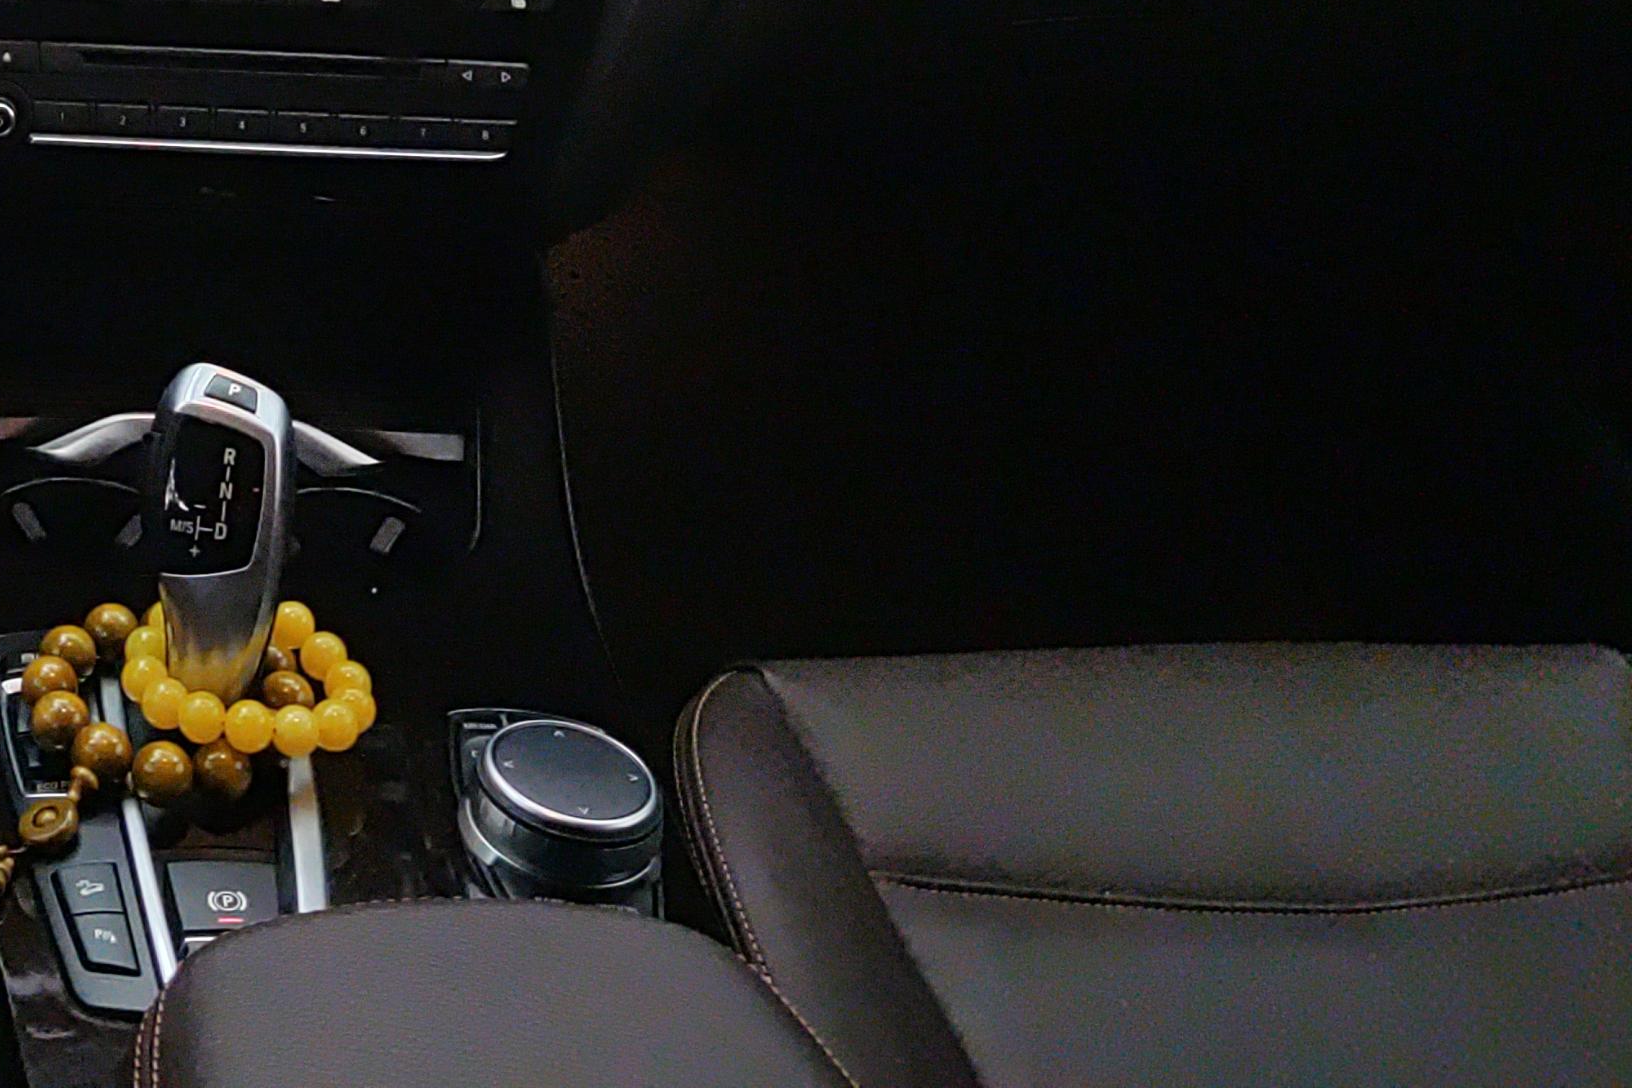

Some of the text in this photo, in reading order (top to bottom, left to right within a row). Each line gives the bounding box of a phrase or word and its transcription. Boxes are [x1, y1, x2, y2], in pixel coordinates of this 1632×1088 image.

[228, 383, 241, 396] P
[223, 447, 237, 466] R
[219, 481, 233, 500] N
[169, 518, 194, 535] M/S
[214, 522, 228, 540] D
